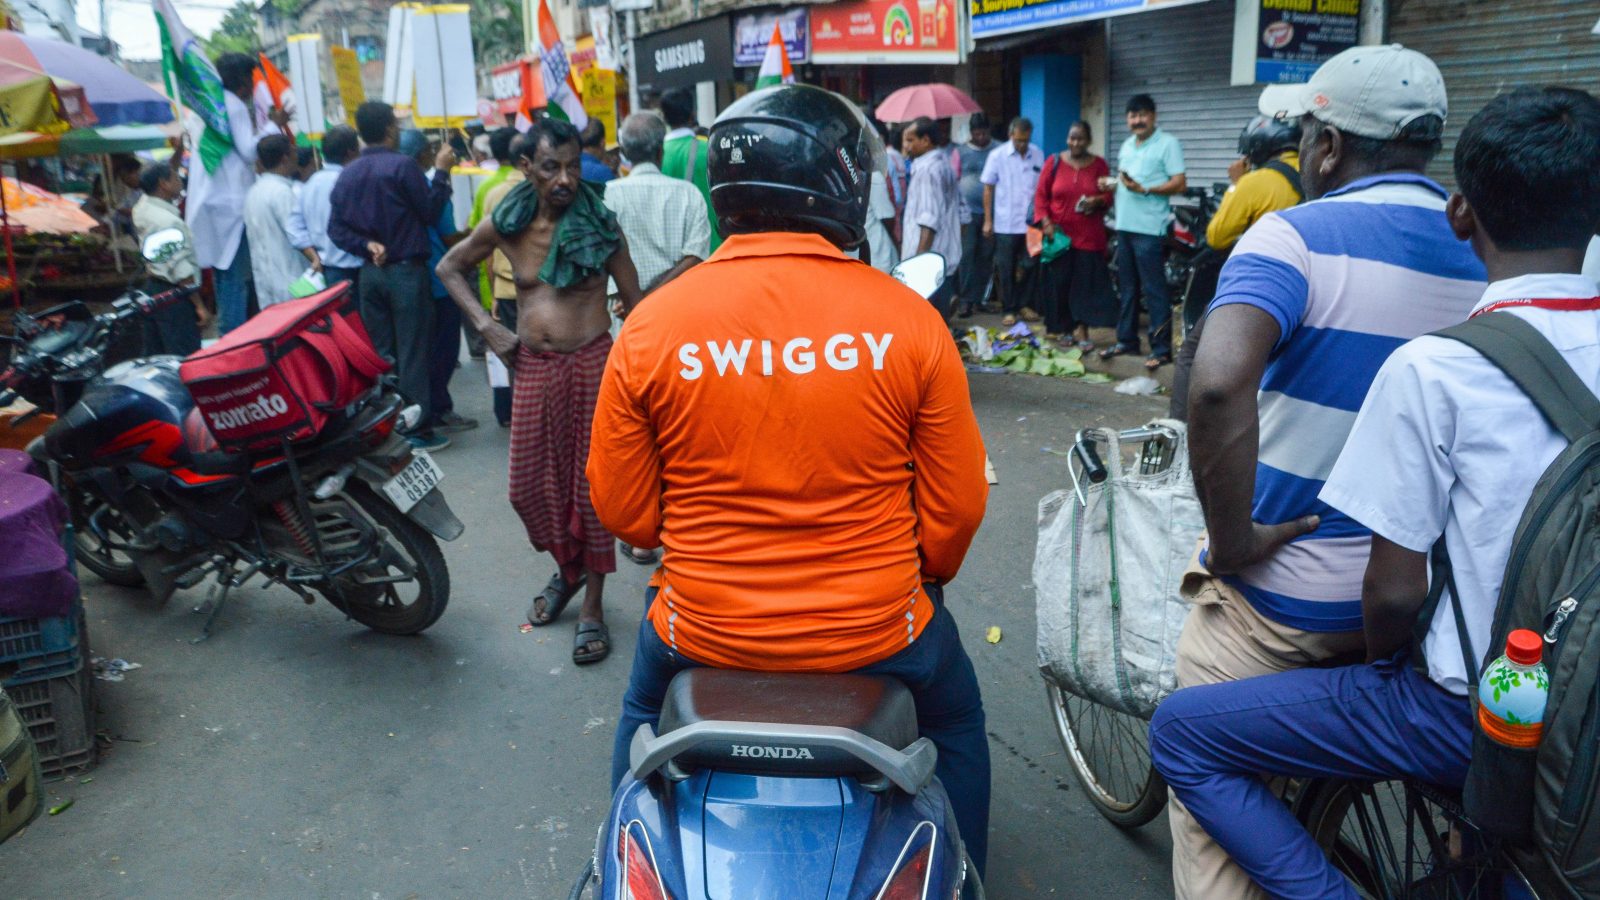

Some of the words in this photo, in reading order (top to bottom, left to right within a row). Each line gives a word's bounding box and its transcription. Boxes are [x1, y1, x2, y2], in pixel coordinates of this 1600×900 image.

[655, 39, 705, 73] SAMSUNG
[678, 332, 894, 380] SWIGGY
[208, 393, 288, 430] zomato
[731, 745, 814, 760] HONDA
